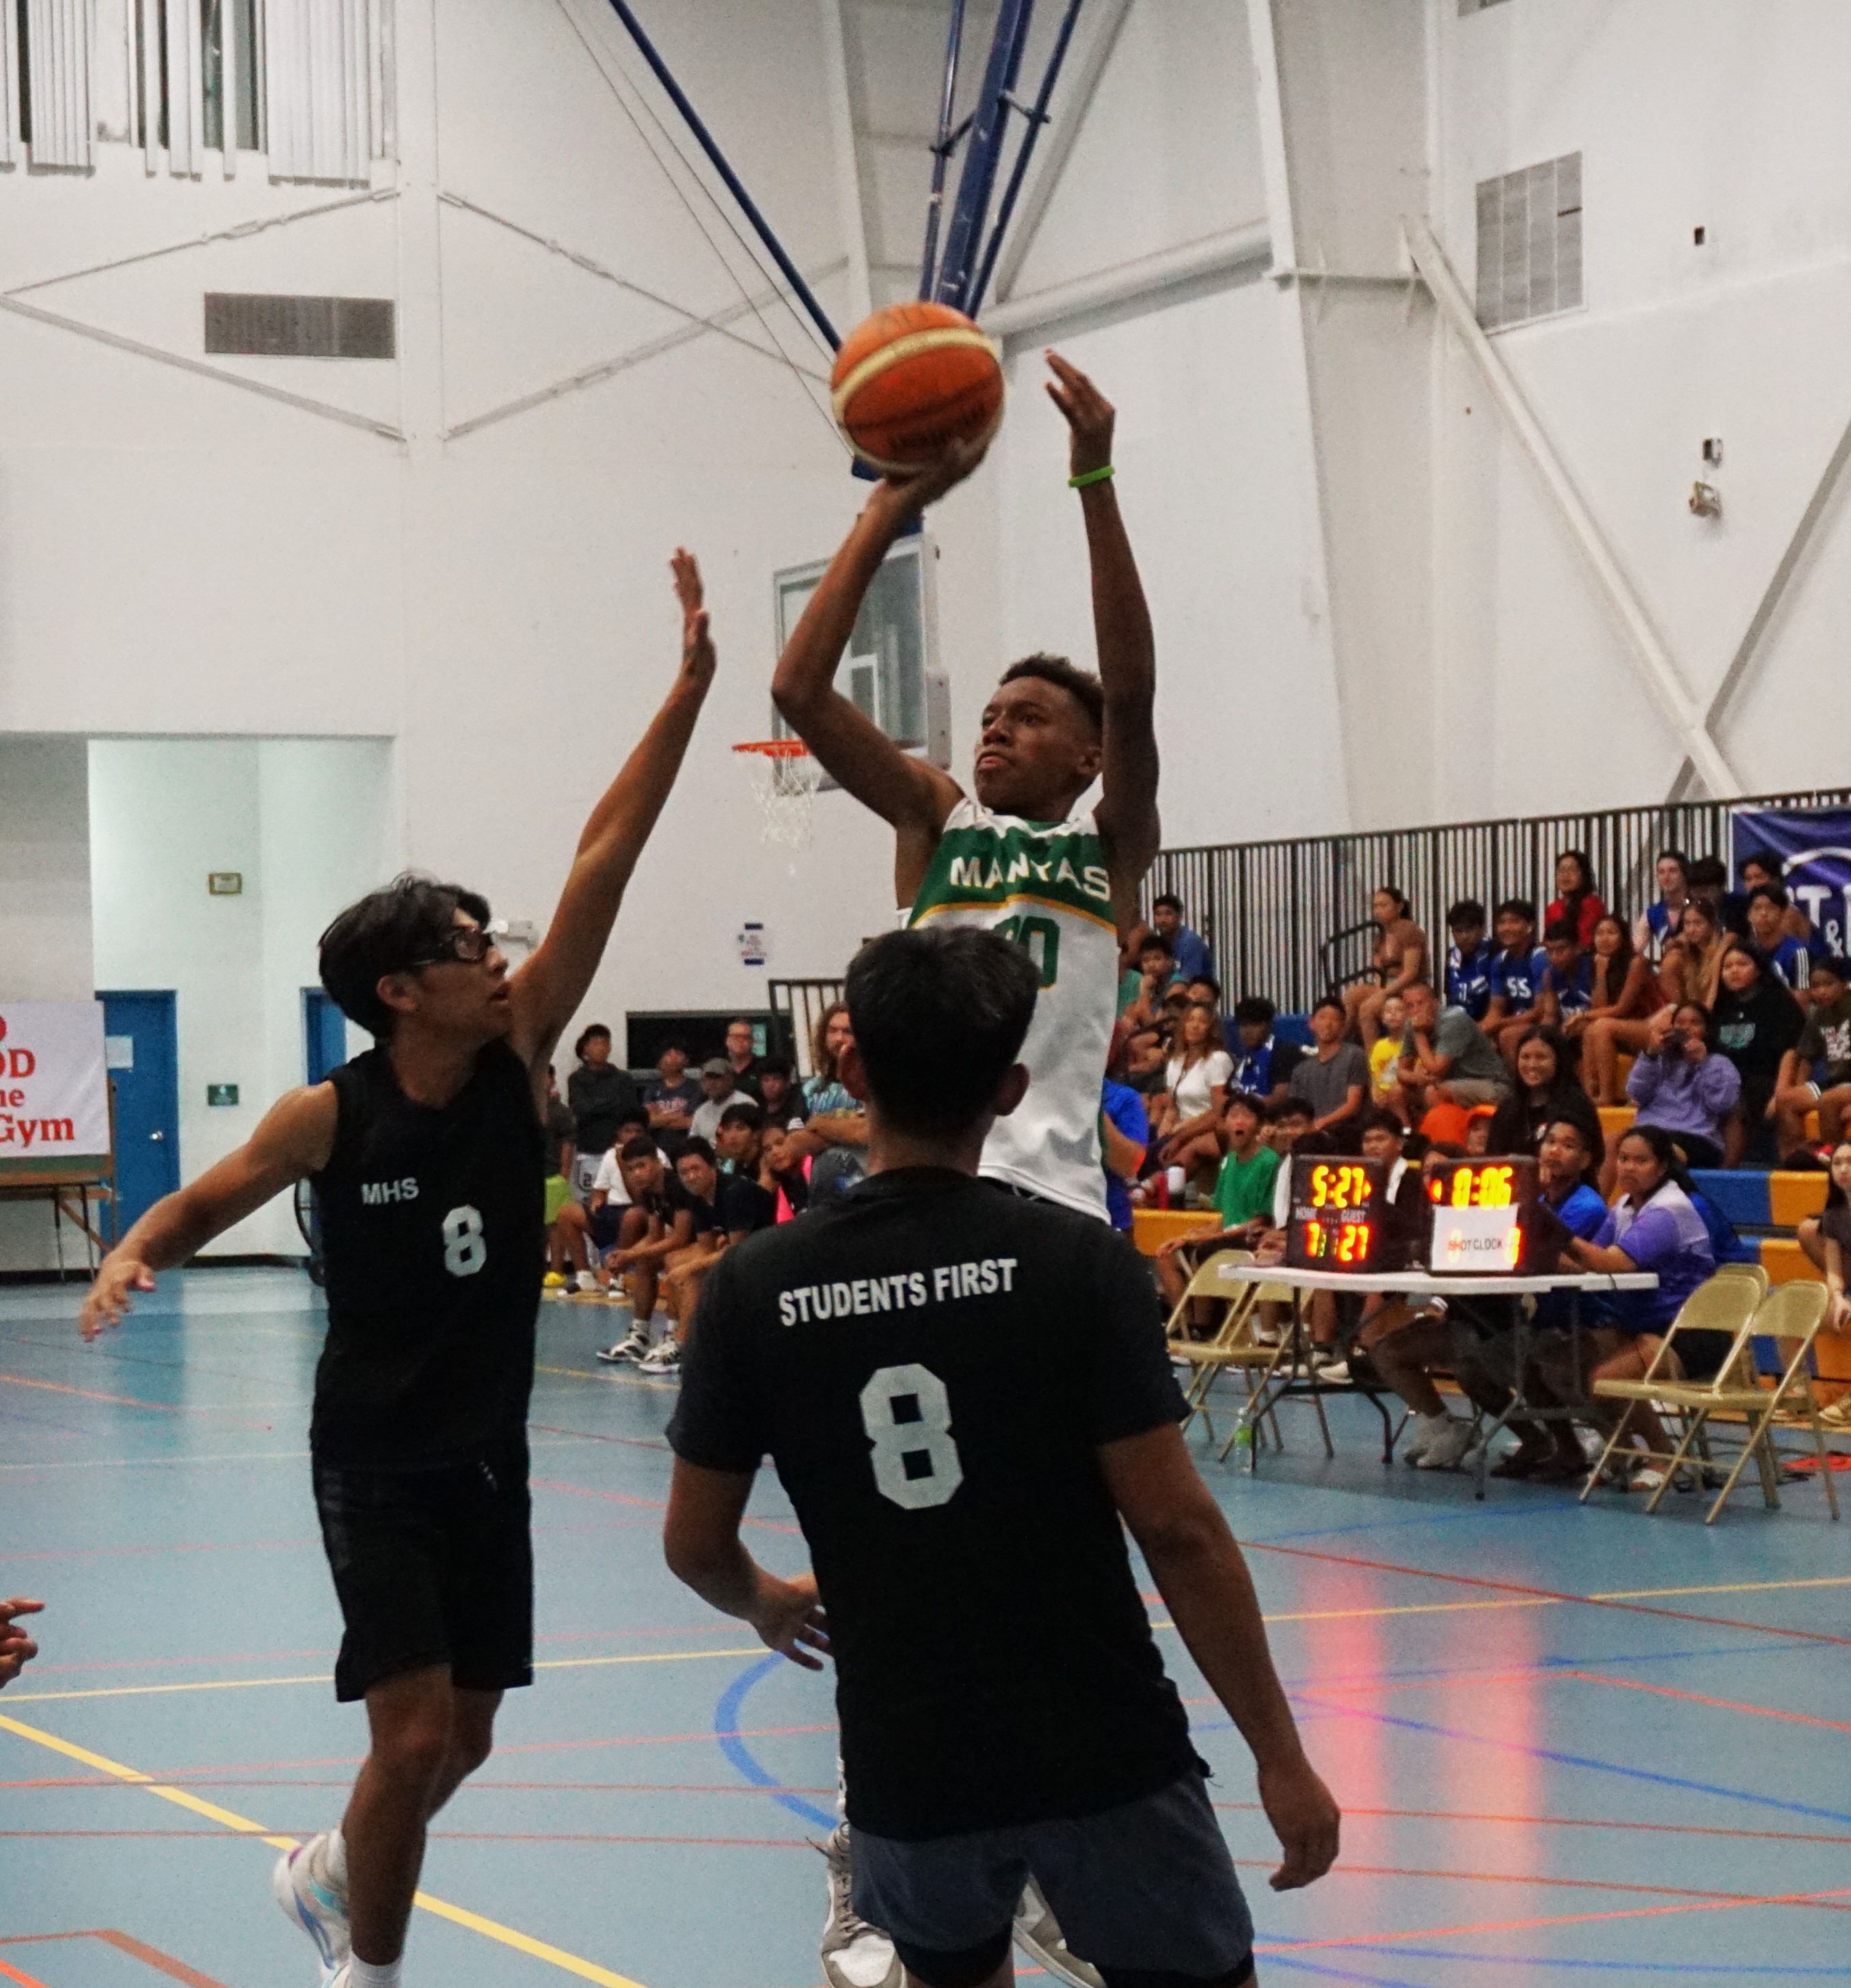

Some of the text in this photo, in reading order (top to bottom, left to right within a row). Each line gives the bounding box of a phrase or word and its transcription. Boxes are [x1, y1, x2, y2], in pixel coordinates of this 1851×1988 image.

[0, 1048, 36, 1078] D
[361, 1177, 419, 1205] MHS
[442, 1205, 487, 1277] 8
[1340, 1209, 1366, 1224] GUEST
[778, 1258, 1018, 1327] STUDENTS FIRST
[859, 1363, 964, 1510] 8
